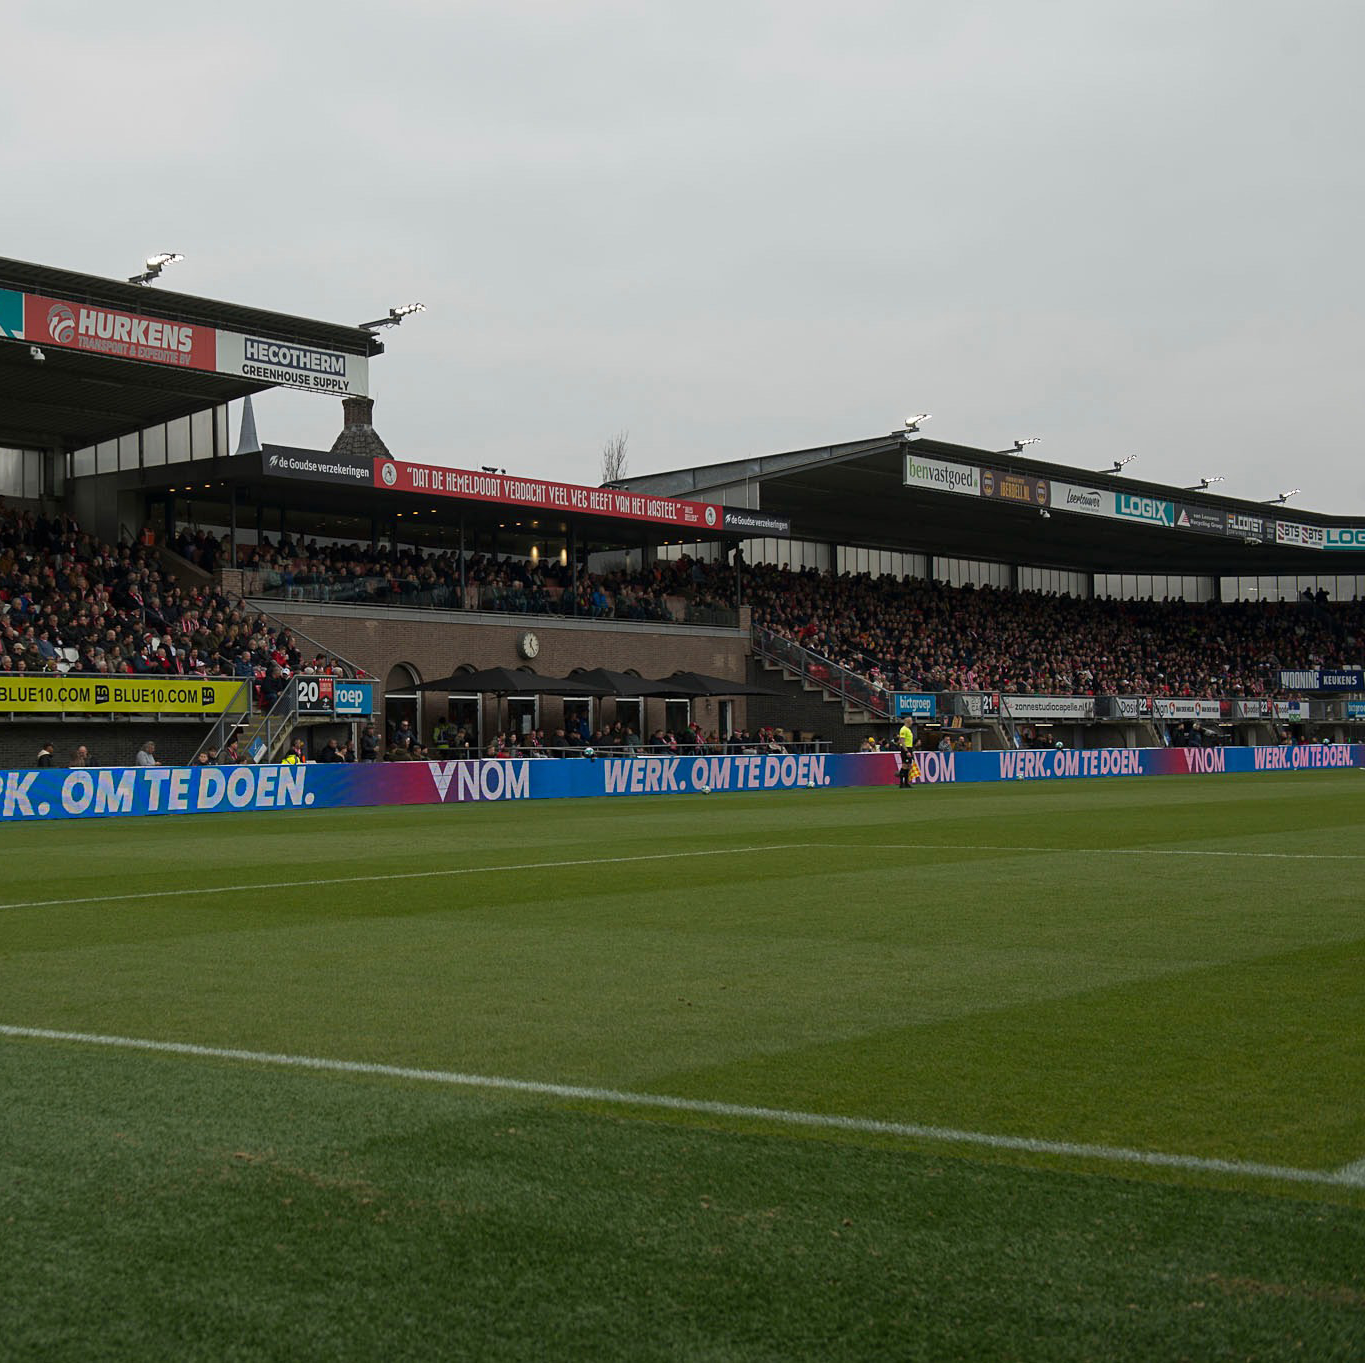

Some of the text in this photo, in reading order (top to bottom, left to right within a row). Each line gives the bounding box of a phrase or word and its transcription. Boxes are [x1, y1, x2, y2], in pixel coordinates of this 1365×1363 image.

[78, 309, 193, 352] HURKENS
[78, 335, 129, 355] TRANSPORT
[138, 345, 179, 363] EXPEDITIE
[245, 341, 344, 375] HECOTHERM
[242, 364, 350, 392] GREENHOUSE SUPPLY
[279, 457, 369, 479] de Goudse verzekeringen
[909, 457, 973, 490] benvastgoed
[432, 472, 444, 490] DE
[446, 472, 501, 498] HEMELPOORT
[504, 480, 547, 503] VERDACHT
[549, 487, 569, 506] VEEL
[570, 489, 588, 508] WEG
[590, 492, 613, 511] HEEFT
[615, 495, 630, 513] VAN
[632, 498, 645, 515] HET
[1120, 496, 1171, 527] LOGIX
[298, 682, 318, 702] 20
[1281, 671, 1357, 689] WOONING KEUKENS
[114, 688, 197, 704] BLUE10.COM
[899, 695, 931, 712] bictgroep
[984, 695, 992, 710] 21
[1139, 699, 1147, 710] 22
[1000, 749, 1143, 779] WERK. OM TE DOEN.
[1254, 745, 1354, 769] WERK. OM TE DOEN.
[428, 760, 529, 803] VNOM
[604, 756, 830, 794] WERK. OM TE DOEN.
[61, 770, 133, 814] OM
[145, 767, 192, 812] TE
[197, 765, 315, 810] DOEN.
